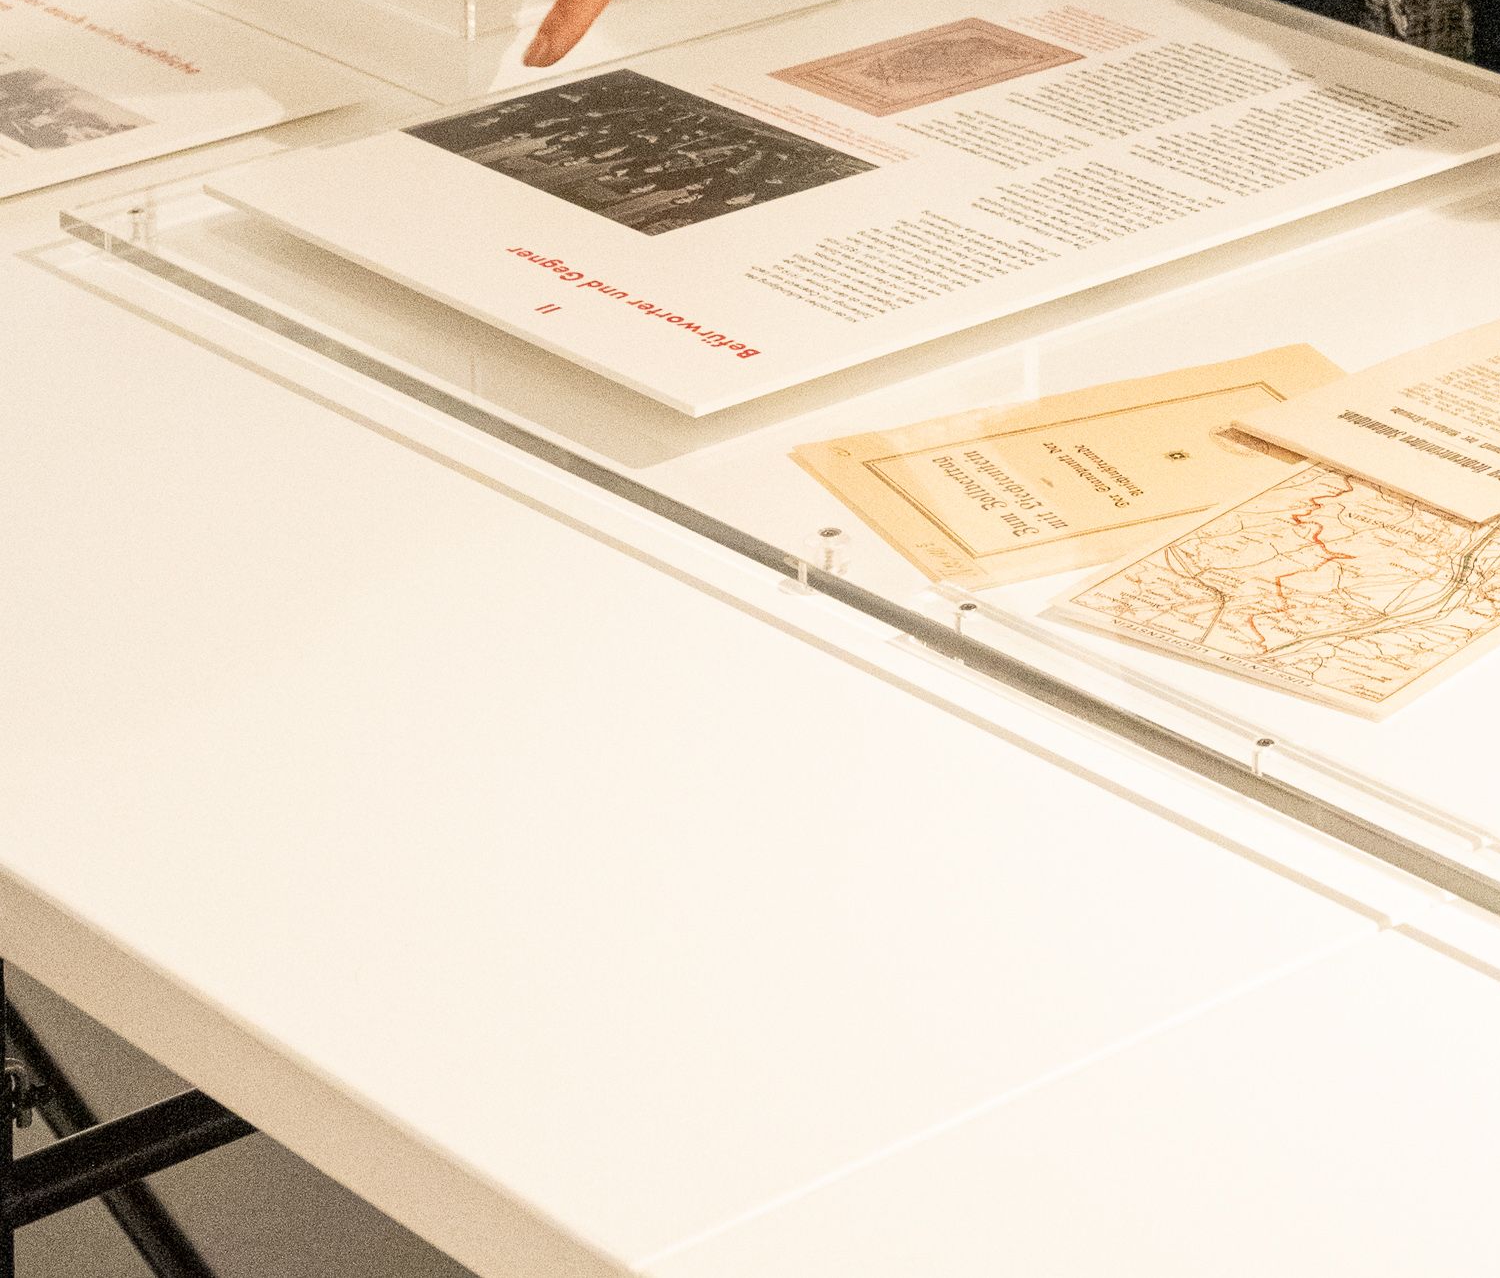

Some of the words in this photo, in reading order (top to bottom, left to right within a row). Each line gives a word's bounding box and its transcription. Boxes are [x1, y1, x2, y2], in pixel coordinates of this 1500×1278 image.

[502, 244, 589, 283] Gegner
[574, 279, 631, 299] und
[530, 302, 564, 315] II
[623, 297, 763, 359] Befürworter
[1037, 441, 1063, 454] der
[923, 455, 1011, 511] Zollvertrag
[954, 449, 1047, 510] Liechtenstein
[1053, 453, 1113, 493] Standpunkt
[1103, 493, 1132, 508] Der
[1031, 510, 1069, 530] mit
